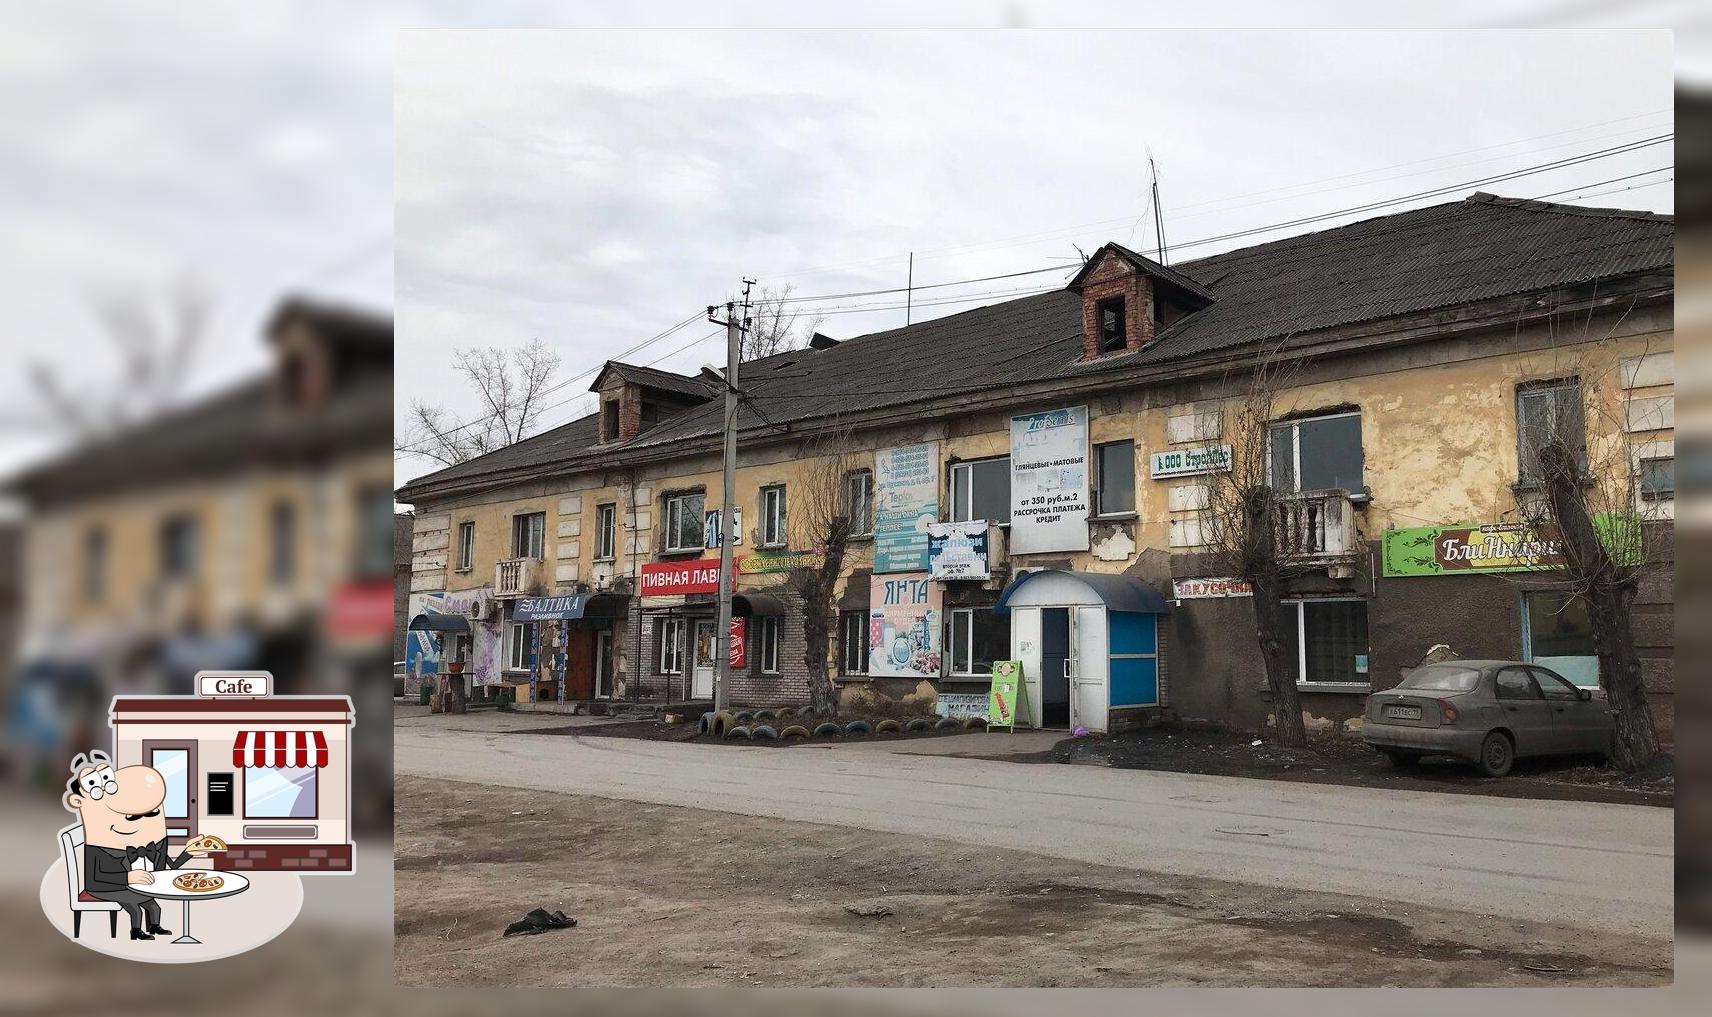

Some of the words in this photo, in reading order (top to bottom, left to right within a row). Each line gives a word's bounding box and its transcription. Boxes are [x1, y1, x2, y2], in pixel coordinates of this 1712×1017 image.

[1015, 461, 1049, 471] ГЛЯНЦЕВЫЕ
[1053, 457, 1084, 466] МАТОВЫЕ
[1165, 454, 1181, 469] ООО
[1031, 496, 1045, 505] 350
[1013, 508, 1051, 517] РАССРОЧКА
[1053, 504, 1086, 513] ПЛАТЕЖА
[1036, 515, 1061, 523] КРЕДИТ
[642, 571, 688, 587] ПИВНАЯ
[691, 568, 722, 585] ЛАВ
[527, 597, 579, 612] БАЛТИКА
